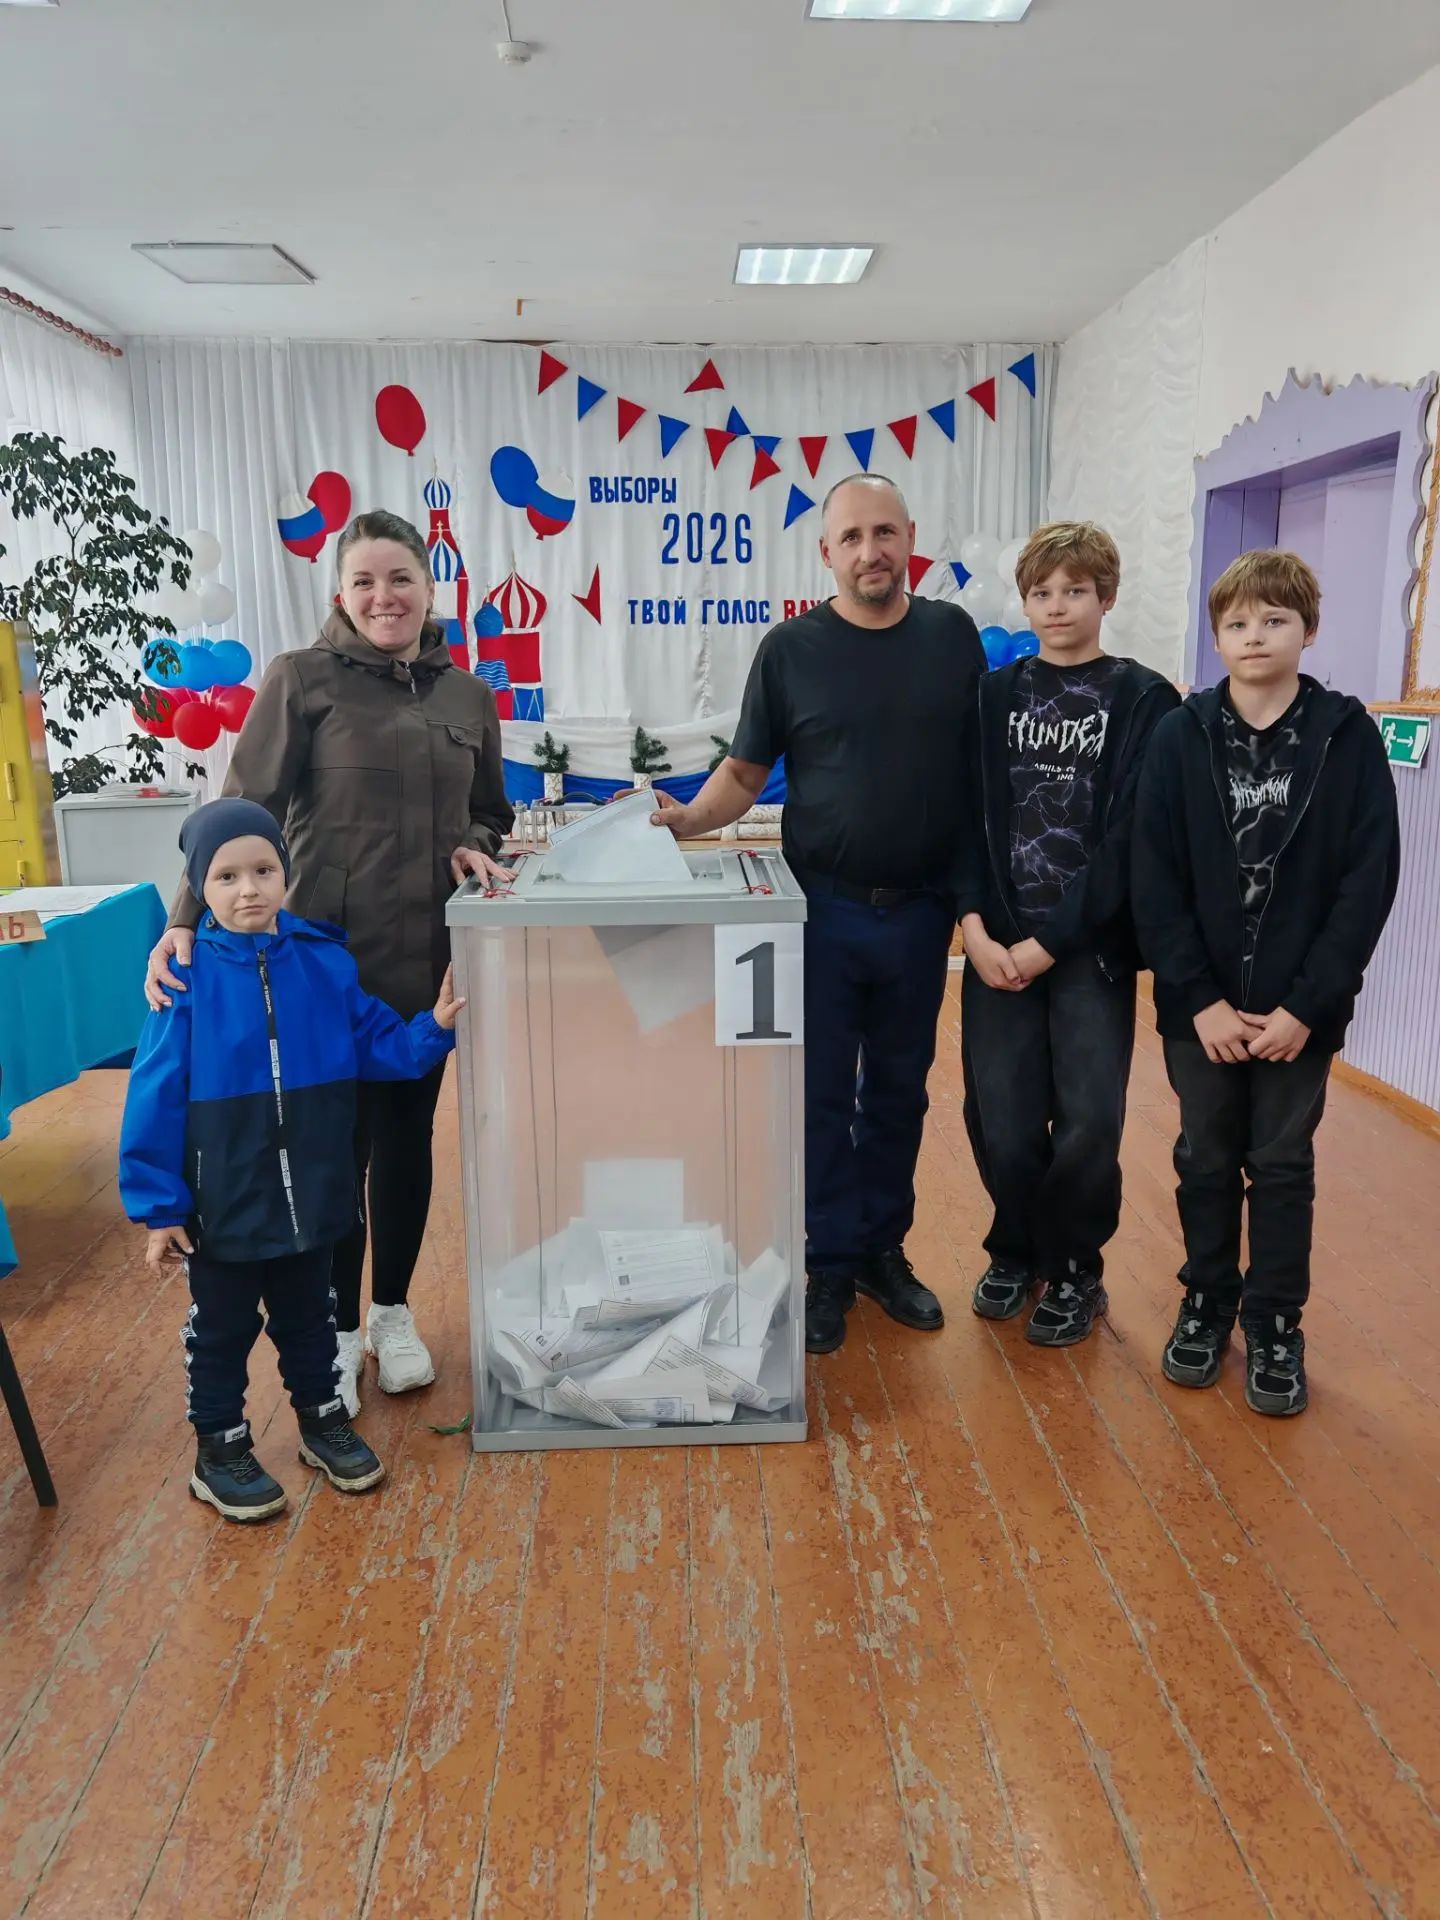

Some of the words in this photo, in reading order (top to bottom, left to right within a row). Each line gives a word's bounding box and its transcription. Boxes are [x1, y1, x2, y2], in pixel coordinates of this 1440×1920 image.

[589, 476, 677, 504] ВЫБОРЫ
[661, 512, 752, 564] 2026
[628, 595, 686, 625] ТВОЙ
[702, 599, 770, 625] ГОЛОС
[783, 599, 821, 622] ВА
[735, 941, 792, 1040] 1
